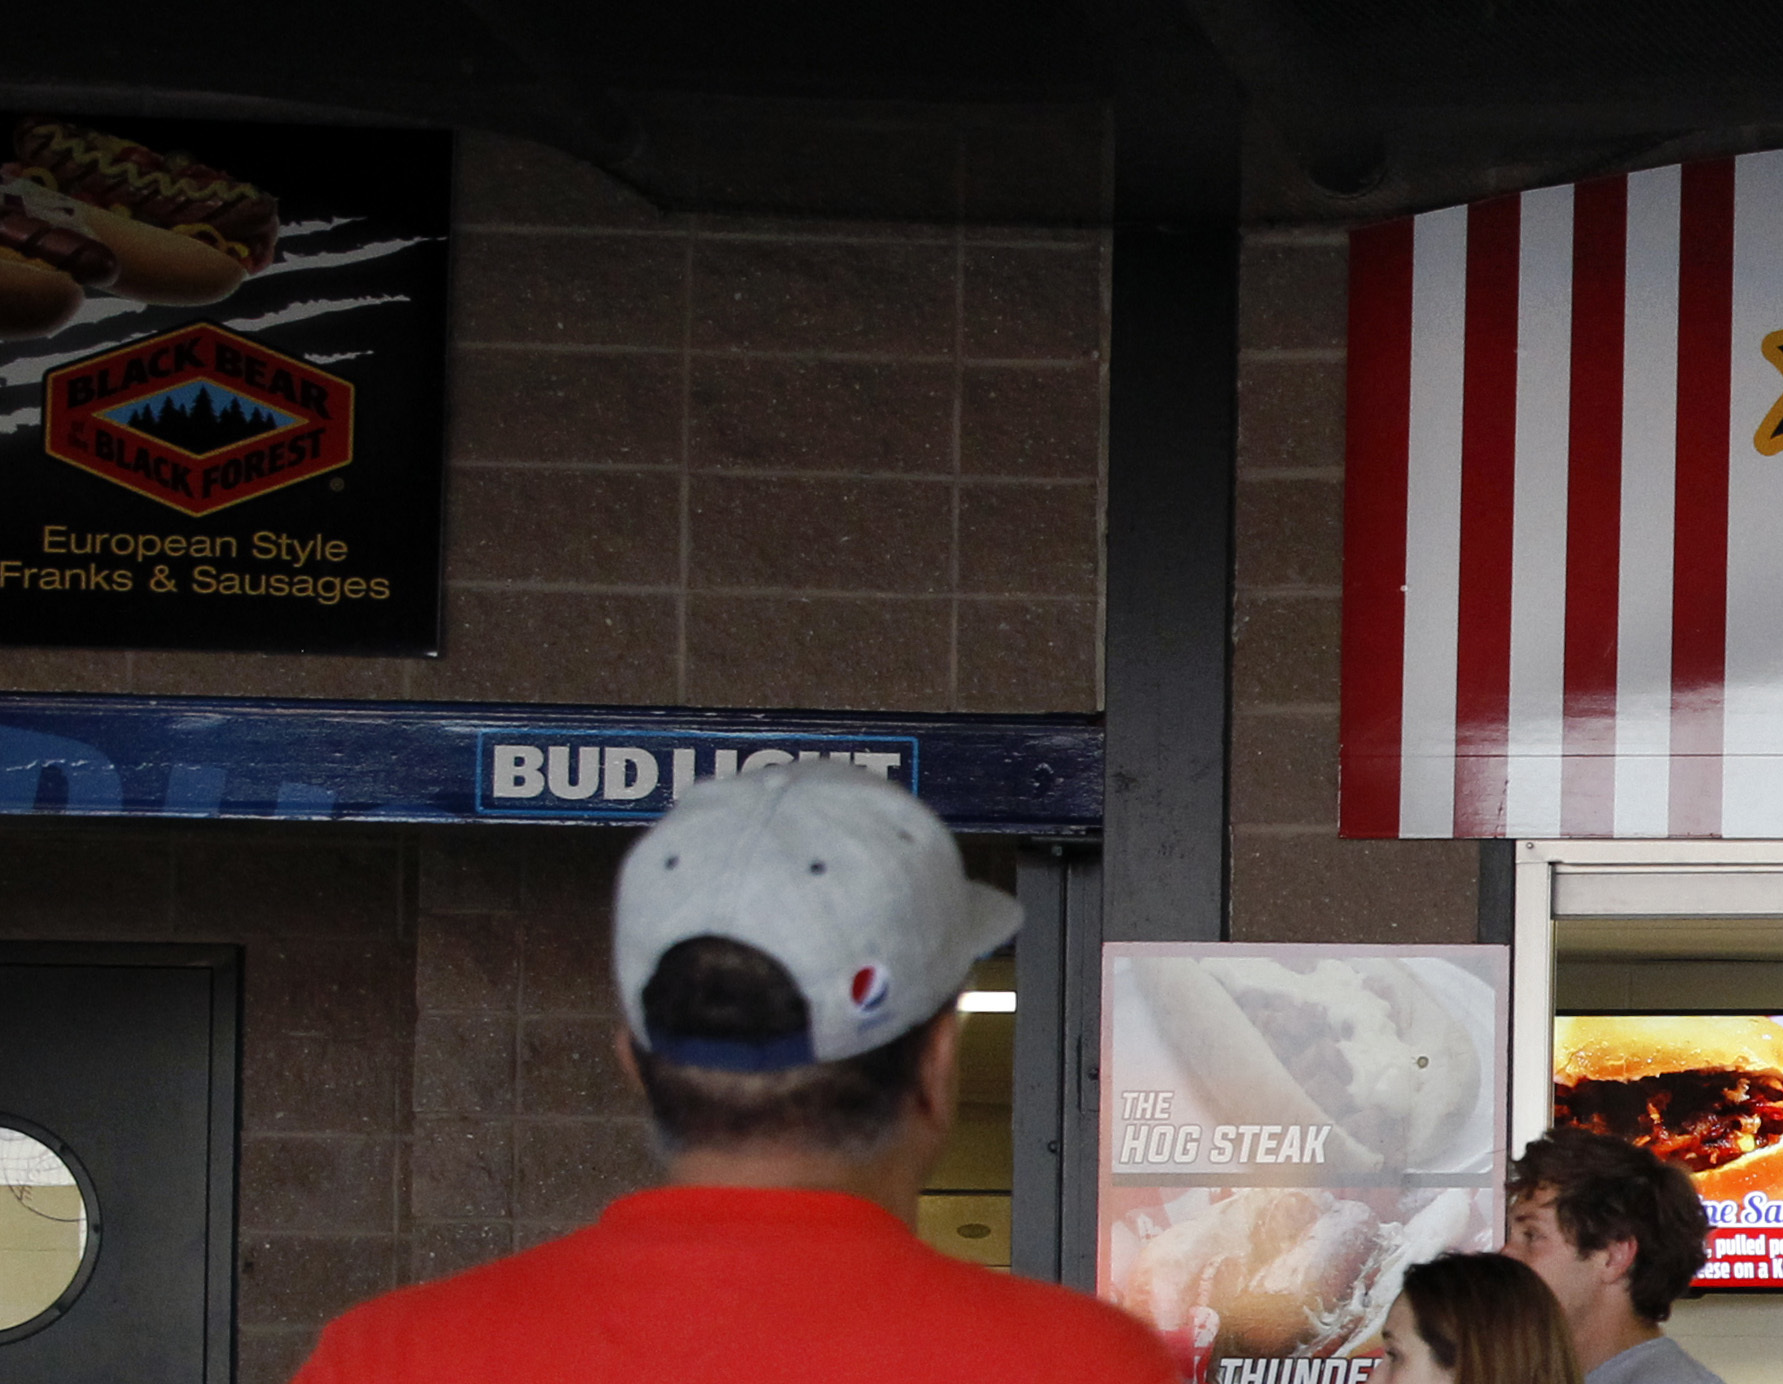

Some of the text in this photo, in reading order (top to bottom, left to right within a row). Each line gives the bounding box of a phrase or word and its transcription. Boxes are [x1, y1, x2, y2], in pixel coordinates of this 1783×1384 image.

[67, 334, 333, 420] BLACK BEAR
[94, 427, 326, 500] BLACK FOREST
[43, 525, 349, 568] European Style
[0, 561, 391, 606] Franks & Sausages
[493, 744, 659, 800] BUD
[1121, 1091, 1174, 1119] THE
[1120, 1124, 1332, 1165] HOG STEAK
[1715, 1234, 1766, 1259] pulled
[1733, 1261, 1754, 1279] on
[1757, 1261, 1768, 1279] a
